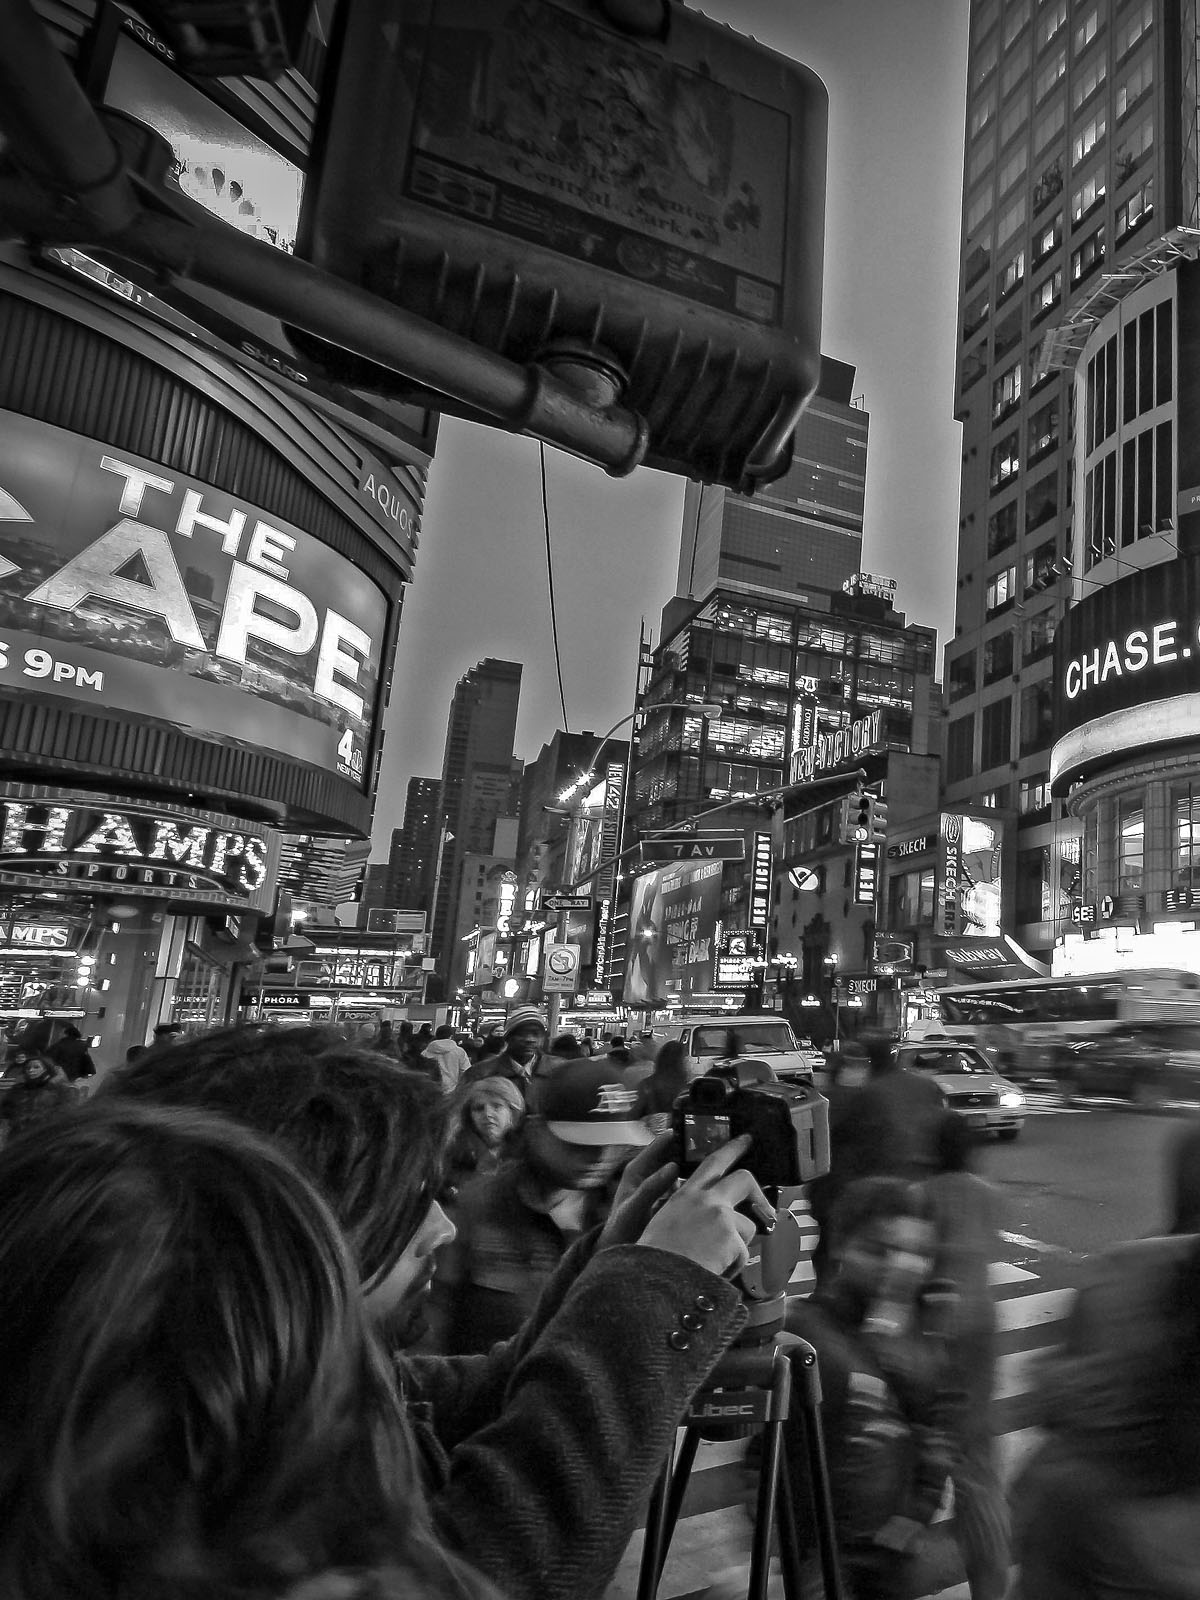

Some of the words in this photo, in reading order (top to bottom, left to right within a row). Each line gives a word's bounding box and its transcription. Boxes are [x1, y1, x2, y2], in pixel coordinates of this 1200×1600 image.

[124, 17, 177, 61] AQUOS
[241, 340, 309, 385] SHARP
[99, 455, 297, 580] THE
[363, 473, 414, 540] AQUOS
[22, 648, 105, 692] 9PM
[337, 728, 354, 767] 4
[818, 709, 881, 769] VICTORY
[608, 763, 623, 786] NEW
[673, 845, 682, 856] 7
[690, 844, 716, 857] Av
[755, 835, 771, 890] VICTORY
[57, 861, 198, 889] SPORTS
[858, 867, 874, 901] NEW
[945, 846, 957, 930] SKECHERS
[752, 897, 768, 924] NEW
[945, 947, 1007, 963] Subway
[689, 1403, 755, 1418] Libec
